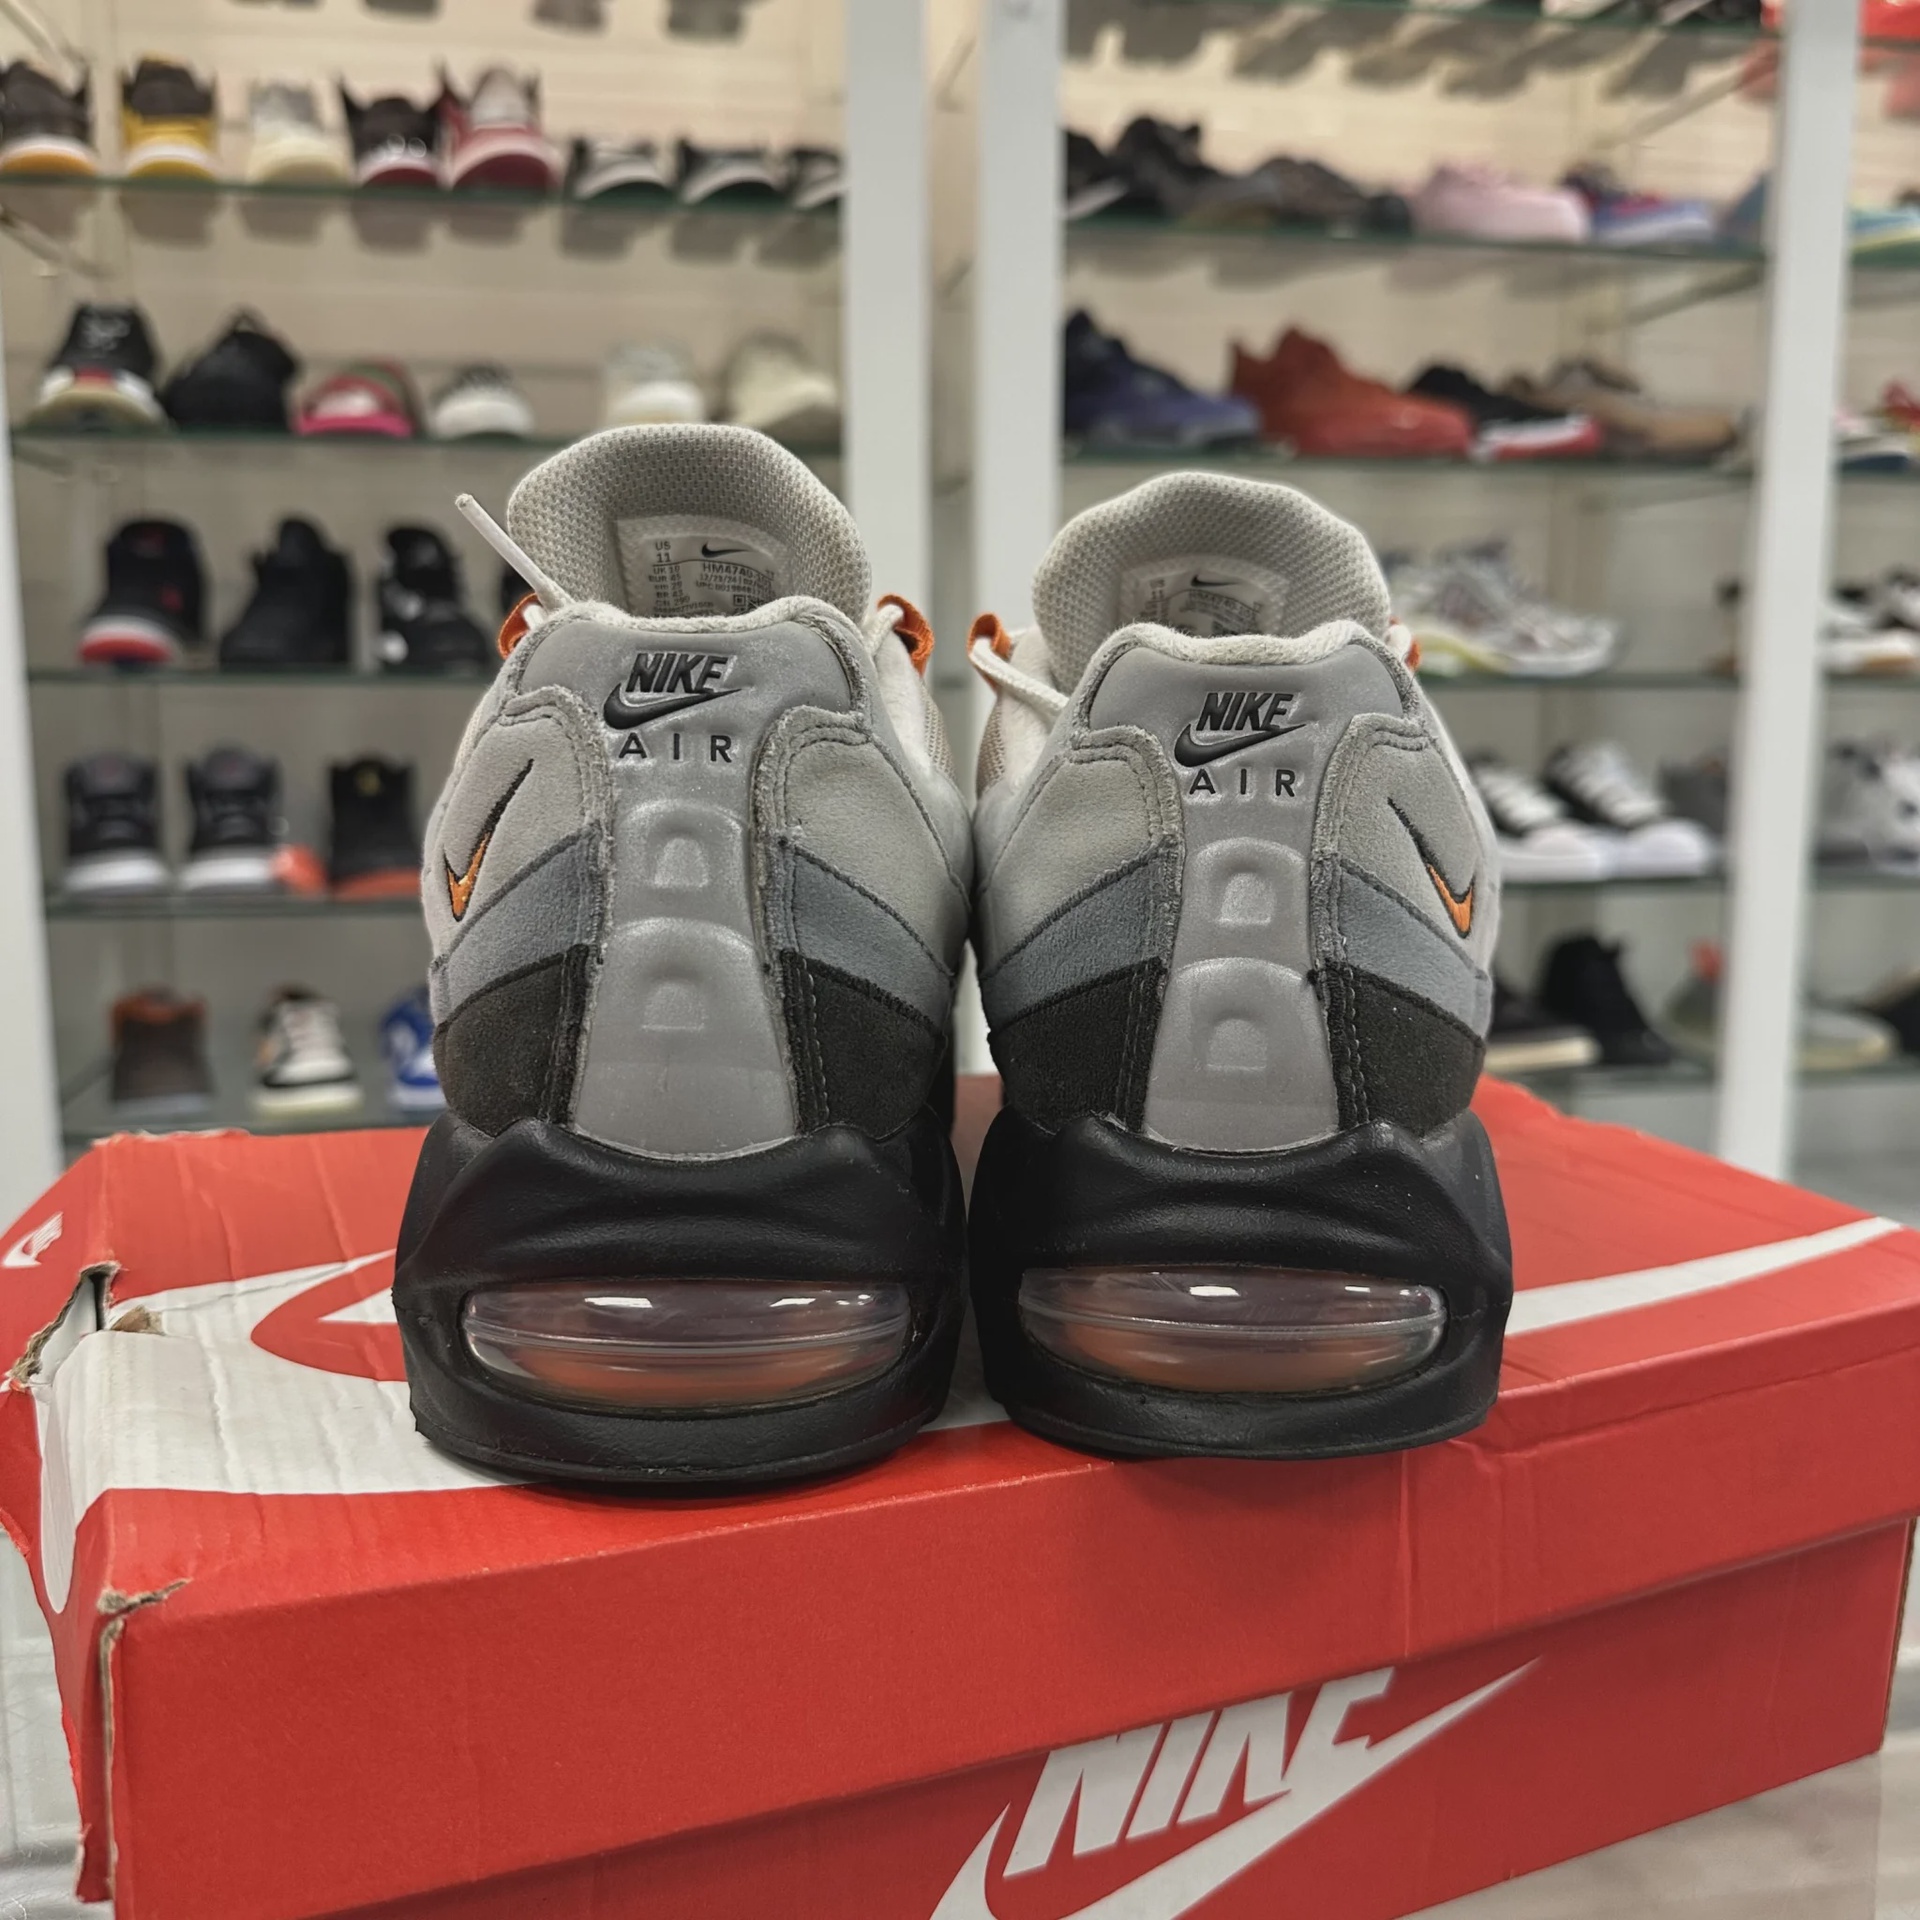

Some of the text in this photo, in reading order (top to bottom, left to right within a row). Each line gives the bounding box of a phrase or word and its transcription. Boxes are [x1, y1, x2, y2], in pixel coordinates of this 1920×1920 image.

[655, 541, 671, 551] US
[656, 552, 671, 563] 11
[653, 565, 680, 575] UK 10
[625, 652, 729, 693] NIKE
[1196, 692, 1294, 731] NIKE
[618, 732, 732, 763] AIR
[1189, 768, 1296, 798] AIR
